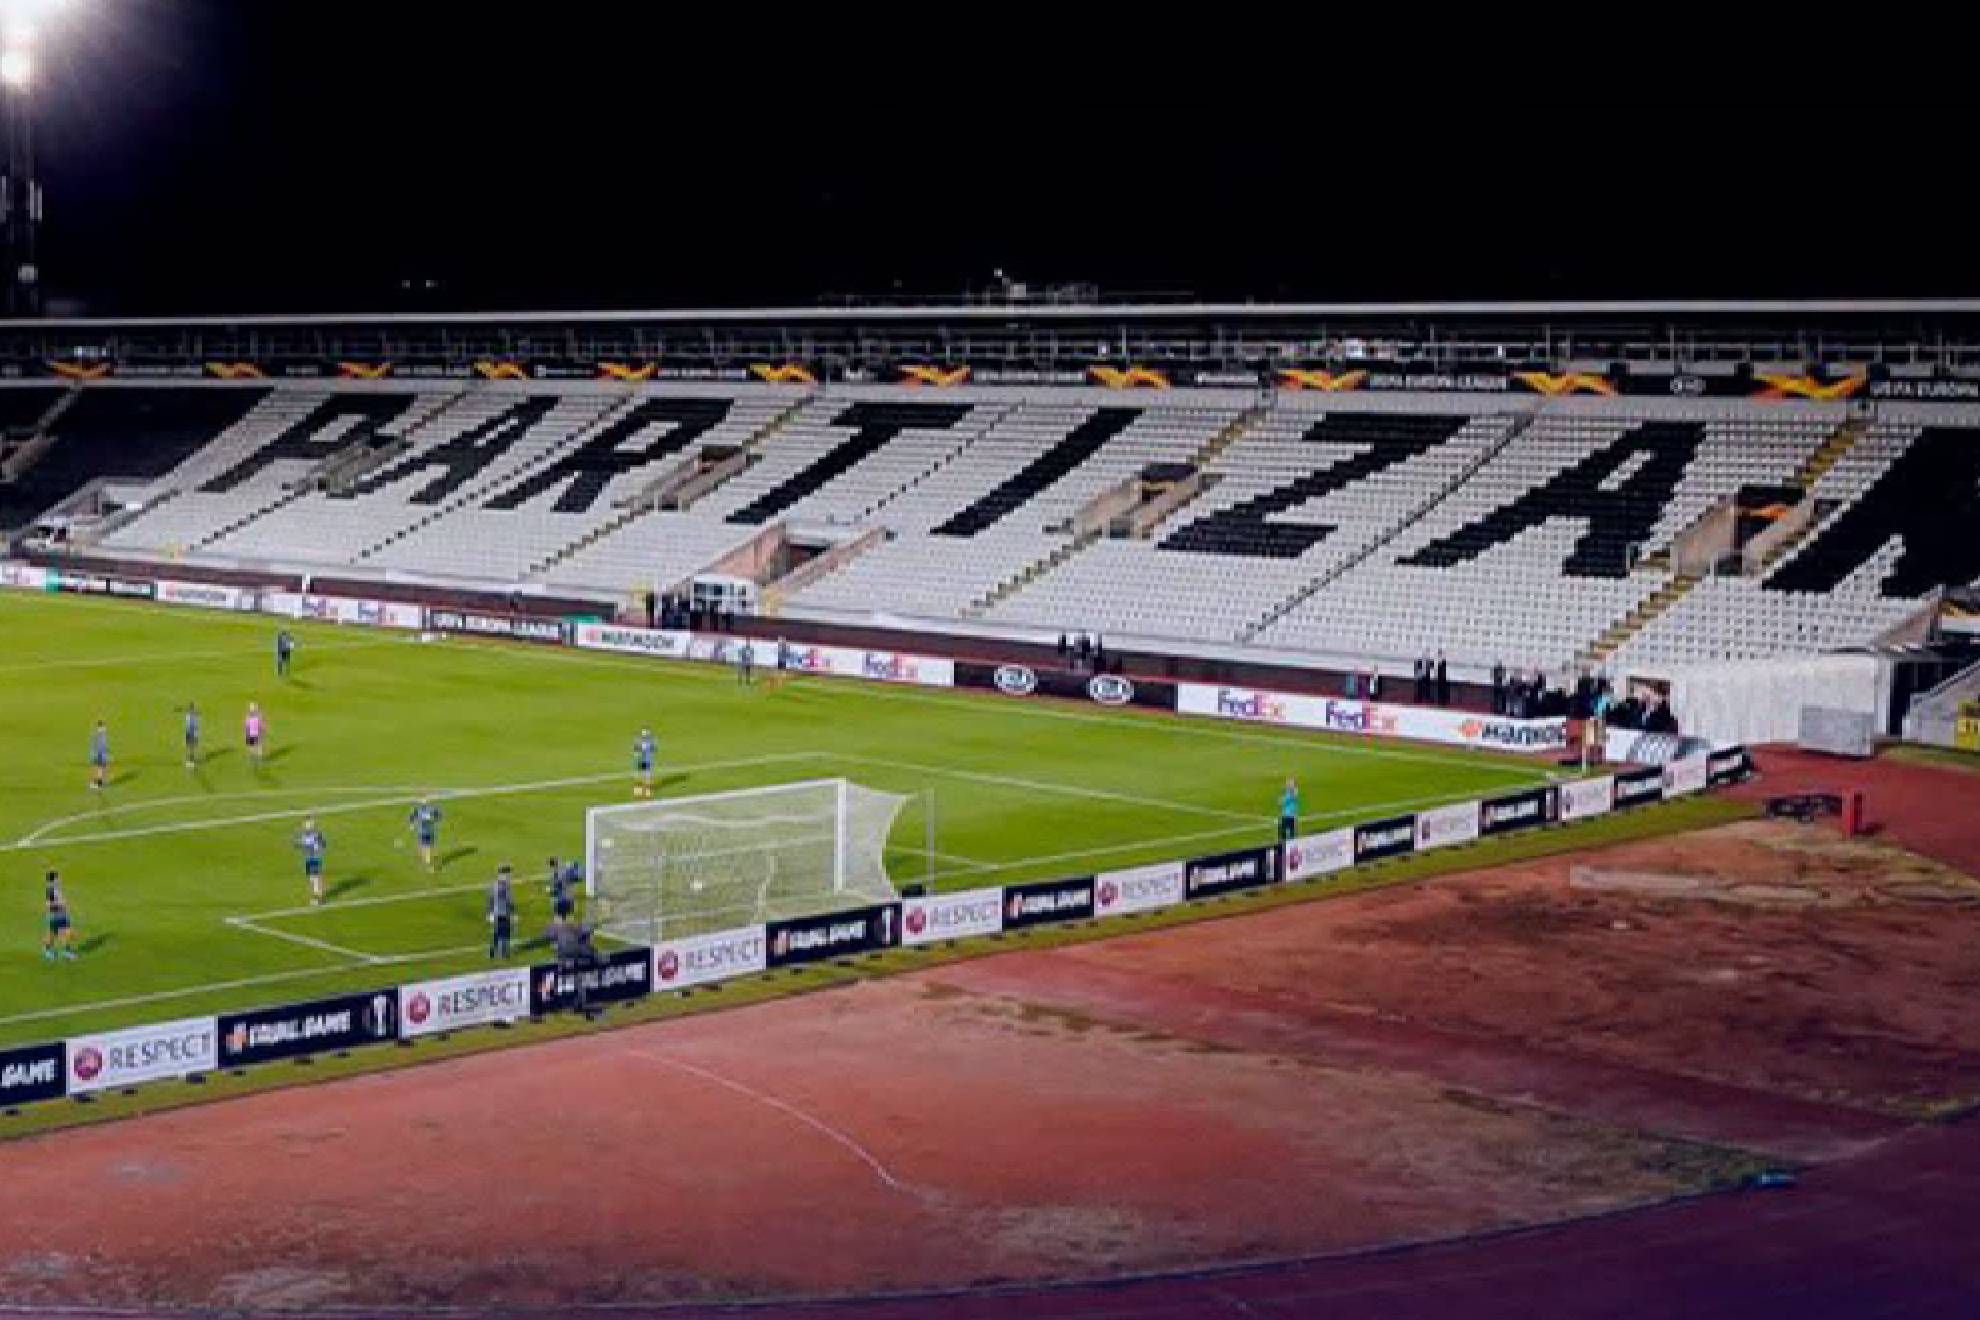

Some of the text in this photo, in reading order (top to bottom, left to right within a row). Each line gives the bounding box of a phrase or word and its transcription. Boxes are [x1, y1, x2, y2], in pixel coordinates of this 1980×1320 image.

[1218, 687, 1287, 720] FedEx
[1326, 699, 1398, 731] FedEx
[437, 981, 524, 1017] RESPECT
[109, 1032, 211, 1071] RESPECT
